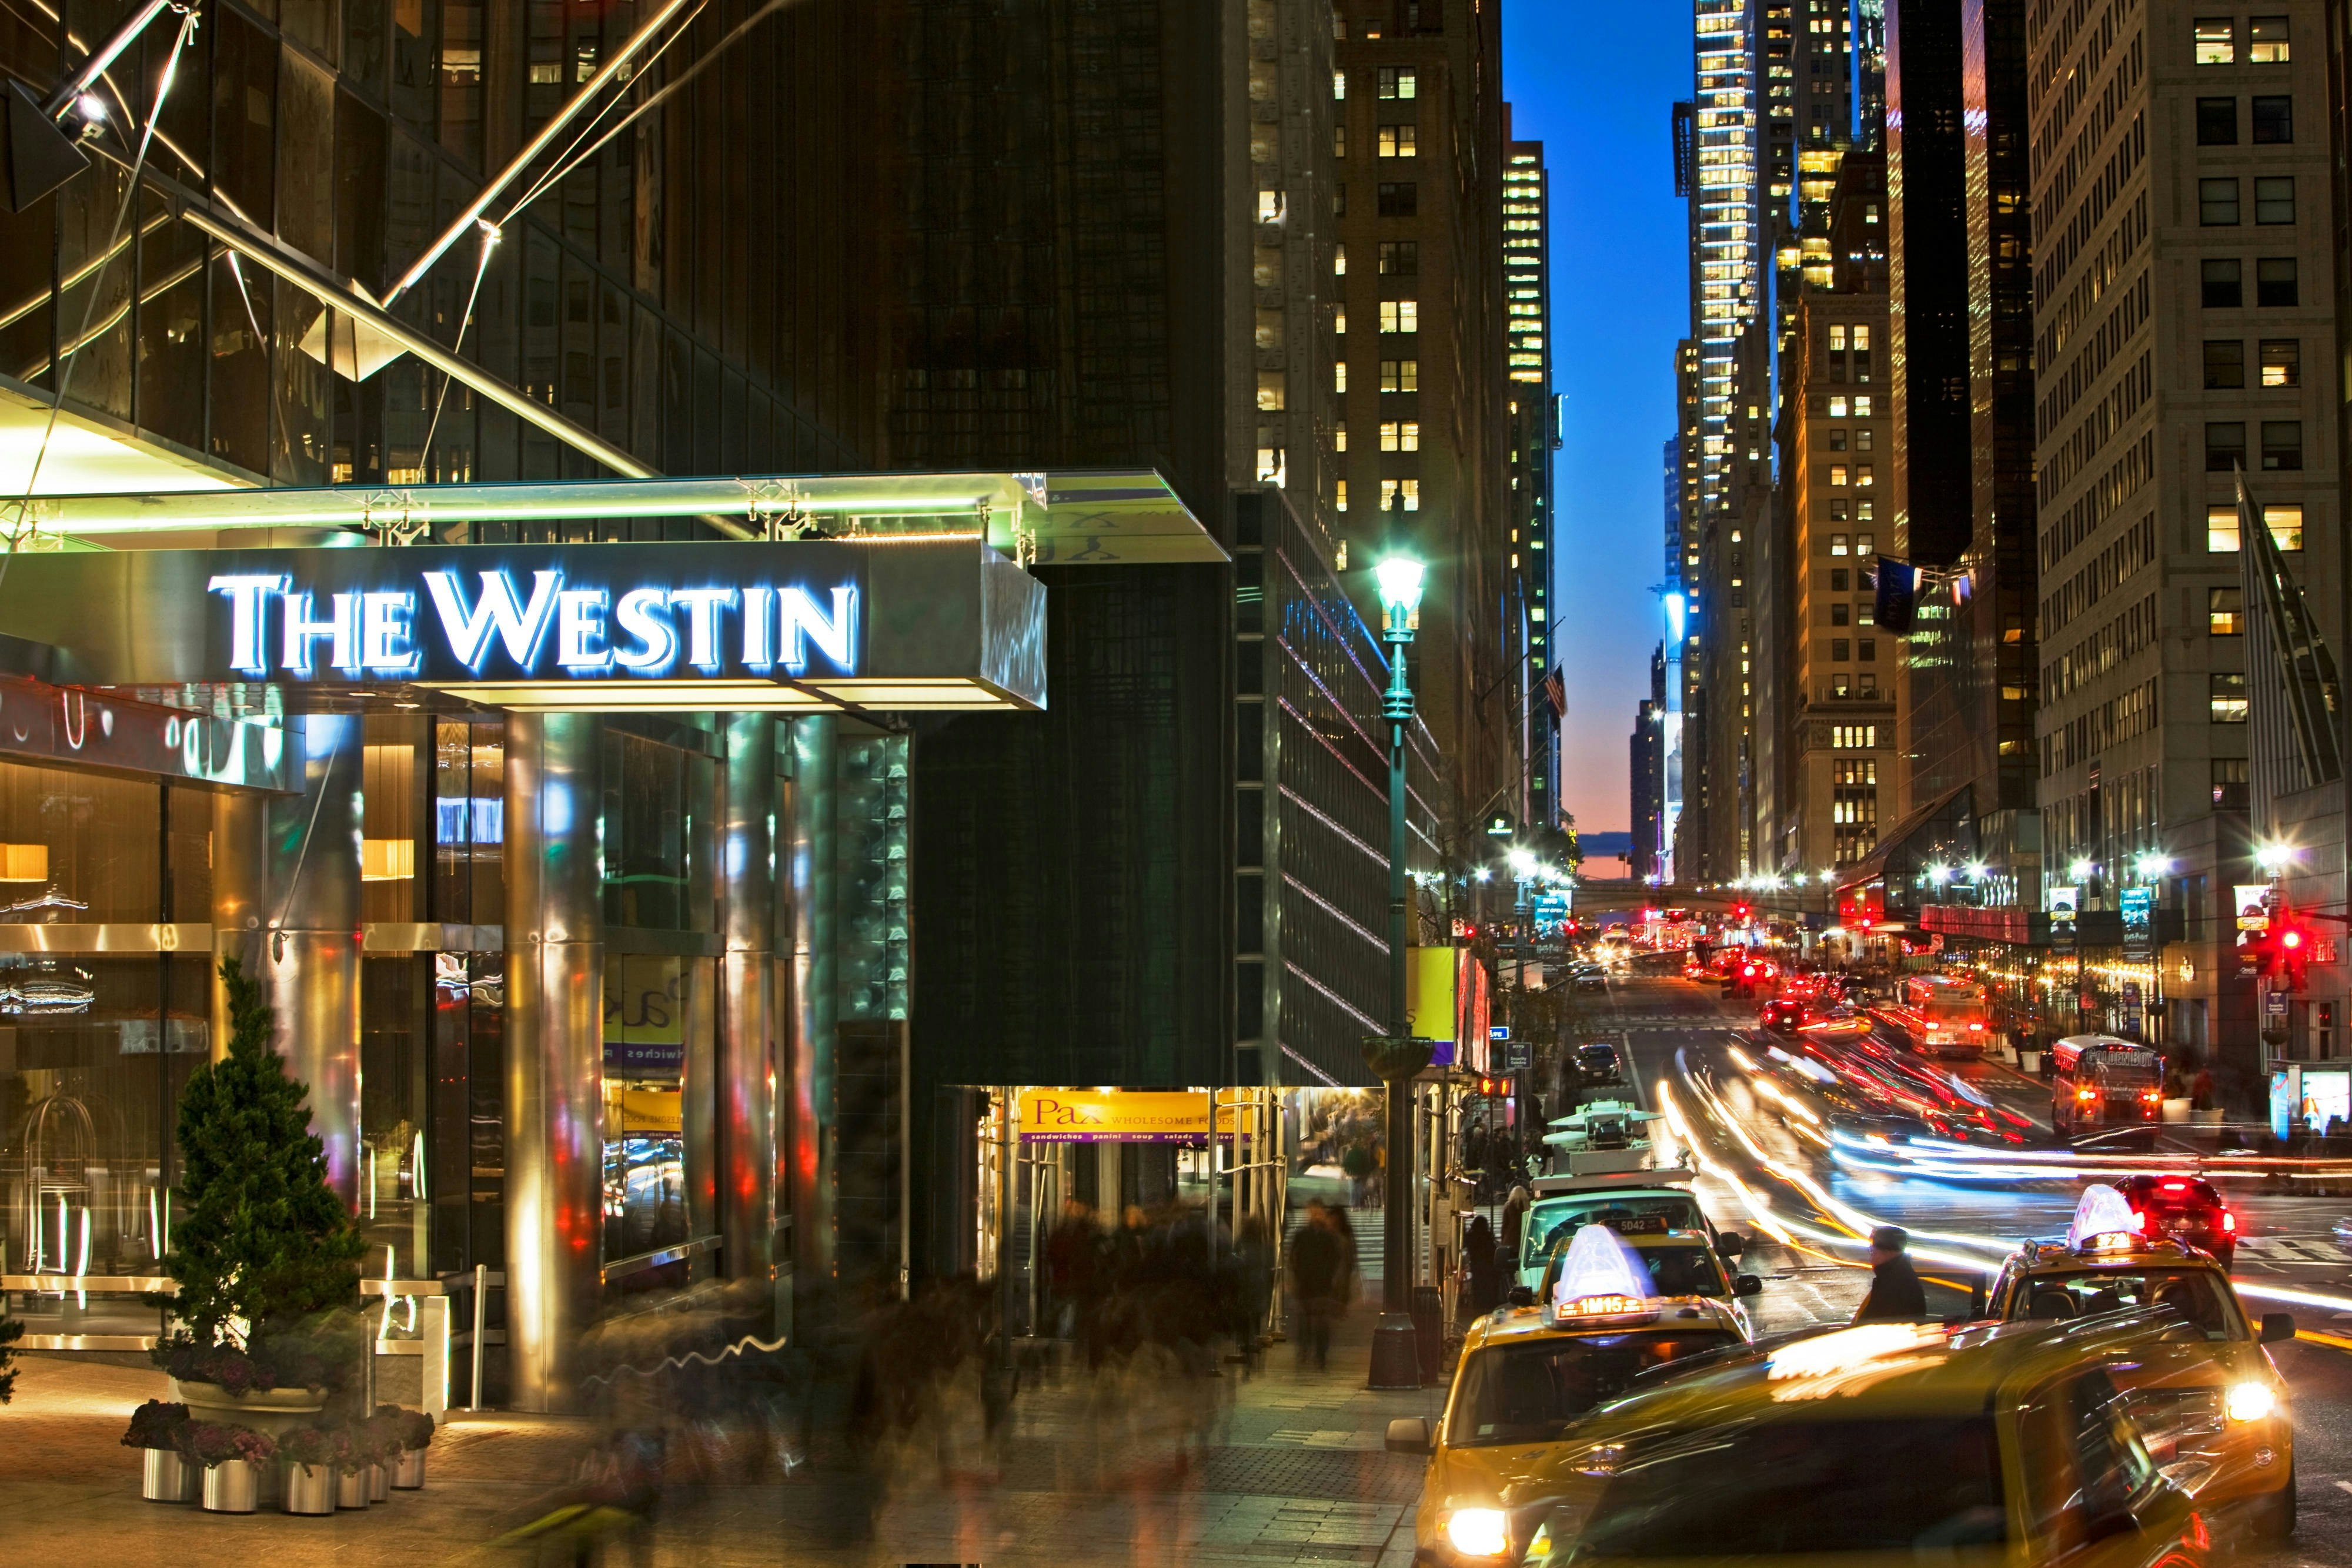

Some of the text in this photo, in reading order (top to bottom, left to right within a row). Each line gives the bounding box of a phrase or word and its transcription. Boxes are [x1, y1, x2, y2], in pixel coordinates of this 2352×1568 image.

[208, 570, 861, 676] THE WESTIN
[2241, 919, 2264, 928] SPY
[1448, 1064, 1464, 1073] M42
[1033, 1099, 1104, 1125] Pax
[1111, 1116, 1192, 1125] WHOLESOME
[1621, 1221, 1645, 1231] 5D42
[1580, 1296, 1622, 1314] 1M15
